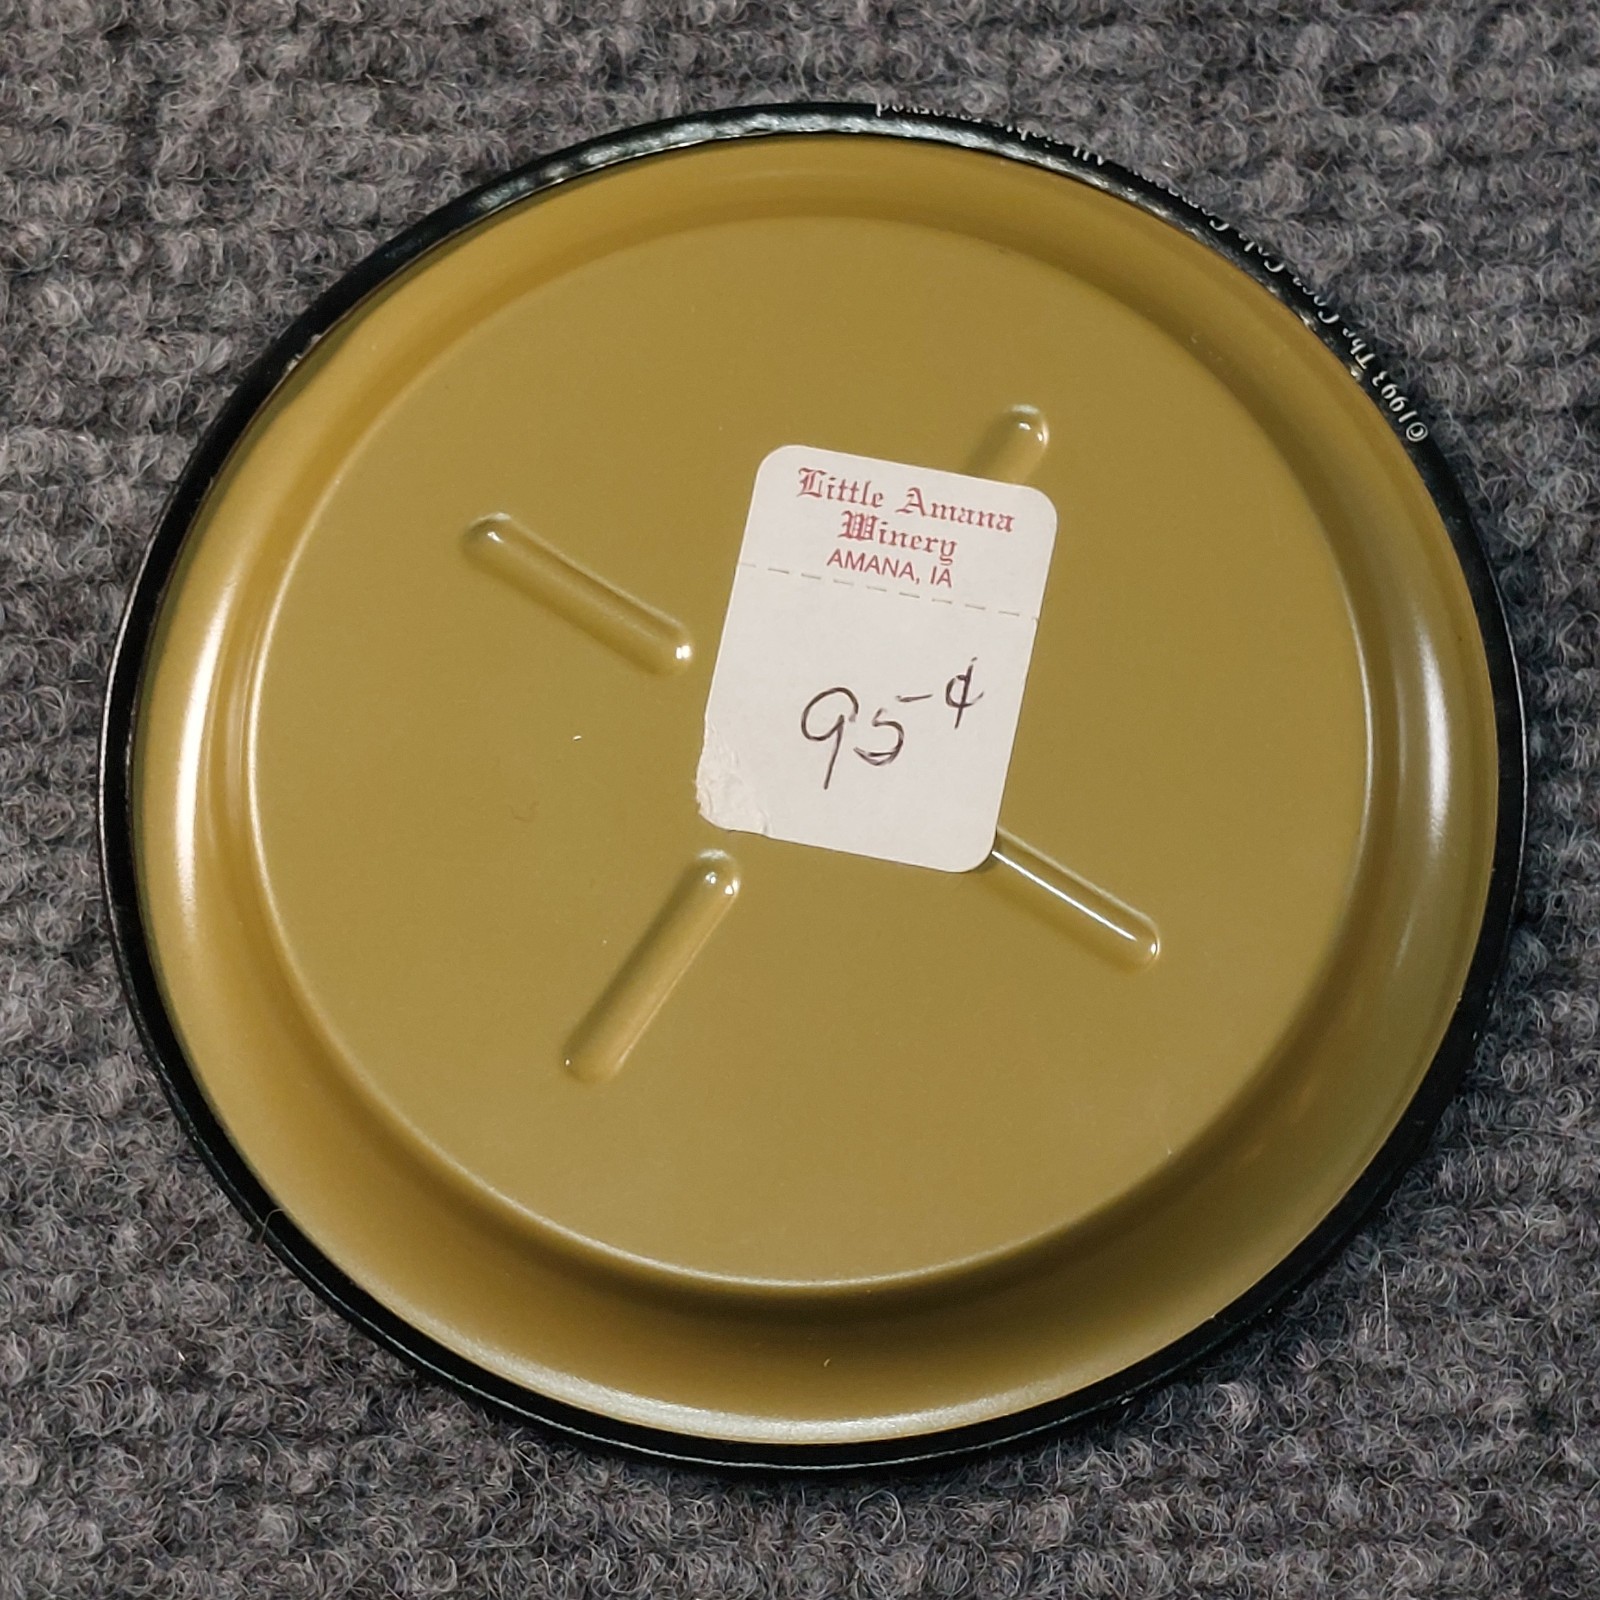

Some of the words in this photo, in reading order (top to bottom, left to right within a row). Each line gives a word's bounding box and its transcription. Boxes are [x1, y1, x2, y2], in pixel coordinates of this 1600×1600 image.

[797, 467, 884, 508] Little
[895, 487, 1015, 532] Amana
[837, 510, 958, 566] Winery
[827, 548, 920, 585] AMANA,
[930, 565, 953, 588] IA
